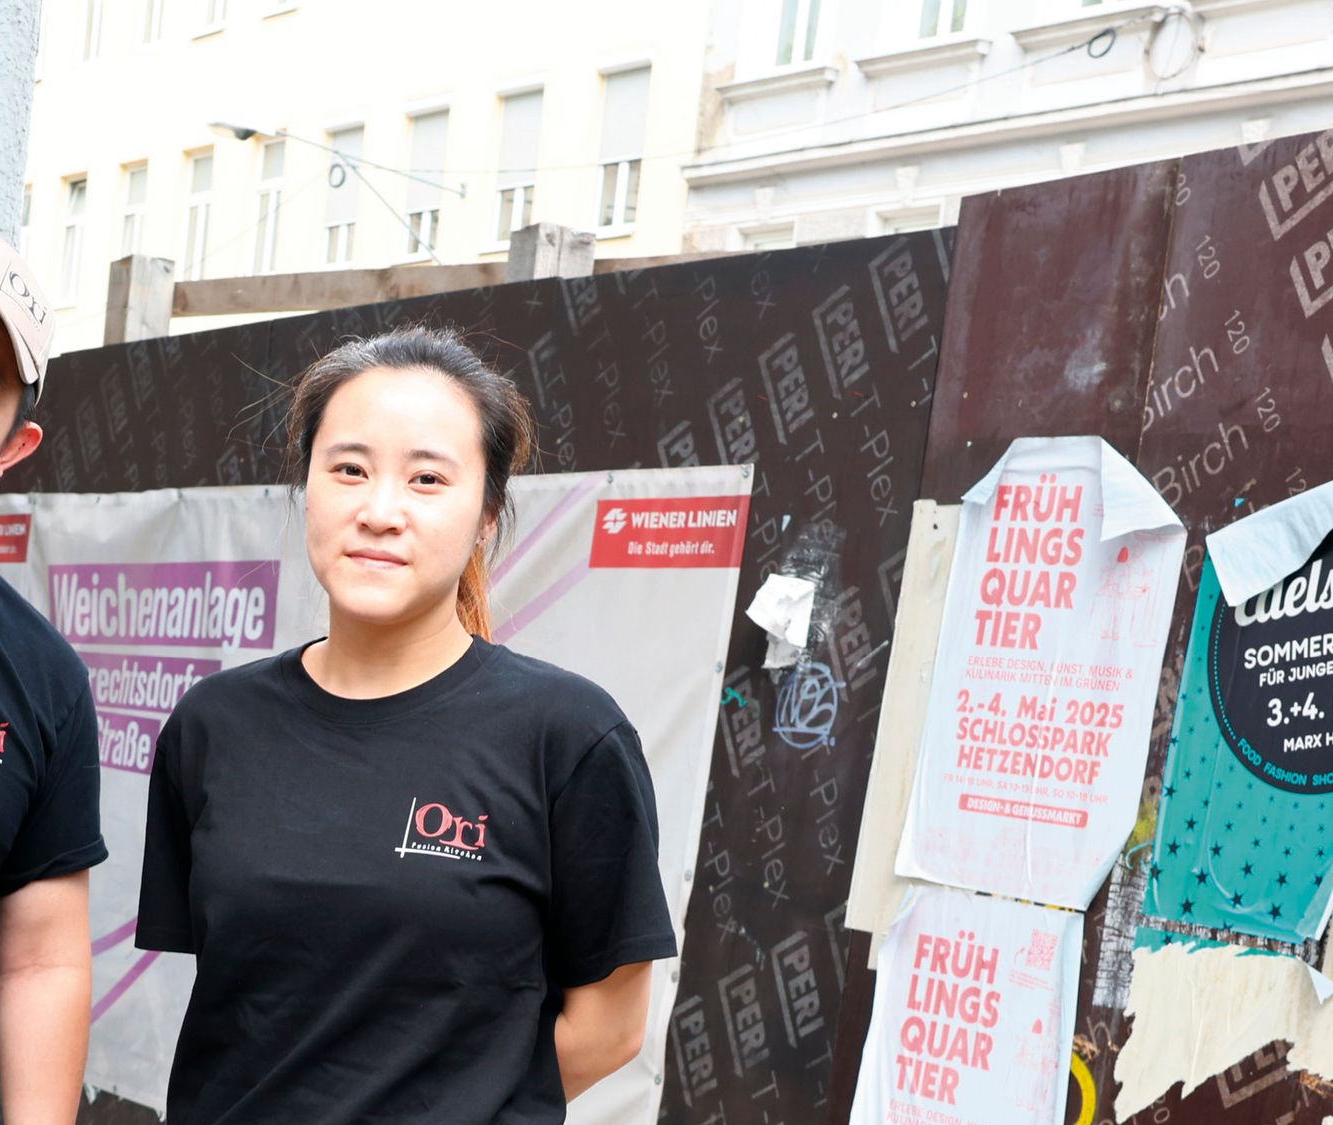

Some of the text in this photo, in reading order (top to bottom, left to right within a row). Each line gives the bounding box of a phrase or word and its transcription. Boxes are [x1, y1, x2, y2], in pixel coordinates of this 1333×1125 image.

[1195, 234, 1220, 279] 120
[884, 250, 929, 342] PERI
[826, 299, 870, 388] PERI
[1224, 309, 1250, 355] 120
[771, 344, 815, 434] PERI
[1255, 387, 1280, 433] 120
[1152, 422, 1249, 508] Birch
[631, 509, 738, 529] WIENER LINIEN
[993, 472, 1083, 524] FRÜH
[627, 540, 715, 558] Die Stadt gehört dir.
[985, 526, 1085, 567] LINGS
[979, 567, 1077, 609] QUAR
[53, 571, 266, 652] Weichenanlage
[974, 609, 1042, 651] TIER
[968, 655, 1005, 669] ERLEBE
[1089, 665, 1123, 679] MUSIK
[1244, 632, 1333, 670] SOMMER
[965, 668, 1017, 682] KULINARIK
[1259, 667, 1284, 688] FÜR
[956, 688, 1008, 718] 2.-4.
[1016, 694, 1058, 722] Mai
[1065, 698, 1125, 730] 2025
[1266, 692, 1325, 727] 3.+4.
[956, 716, 1112, 757] SCHLOSSPARK
[1283, 732, 1322, 753] MARX
[956, 744, 1101, 786] HETZENDORF
[1237, 737, 1307, 786] FOOD FASHION
[415, 802, 489, 851] Ori
[913, 929, 1000, 985] FRÜH
[783, 936, 825, 1038] PERI
[906, 973, 1001, 1029] LINGS
[730, 968, 770, 1069] PERI
[678, 1001, 719, 1099] PERI
[900, 1015, 994, 1072] QUAR
[896, 1054, 960, 1106] TIER
